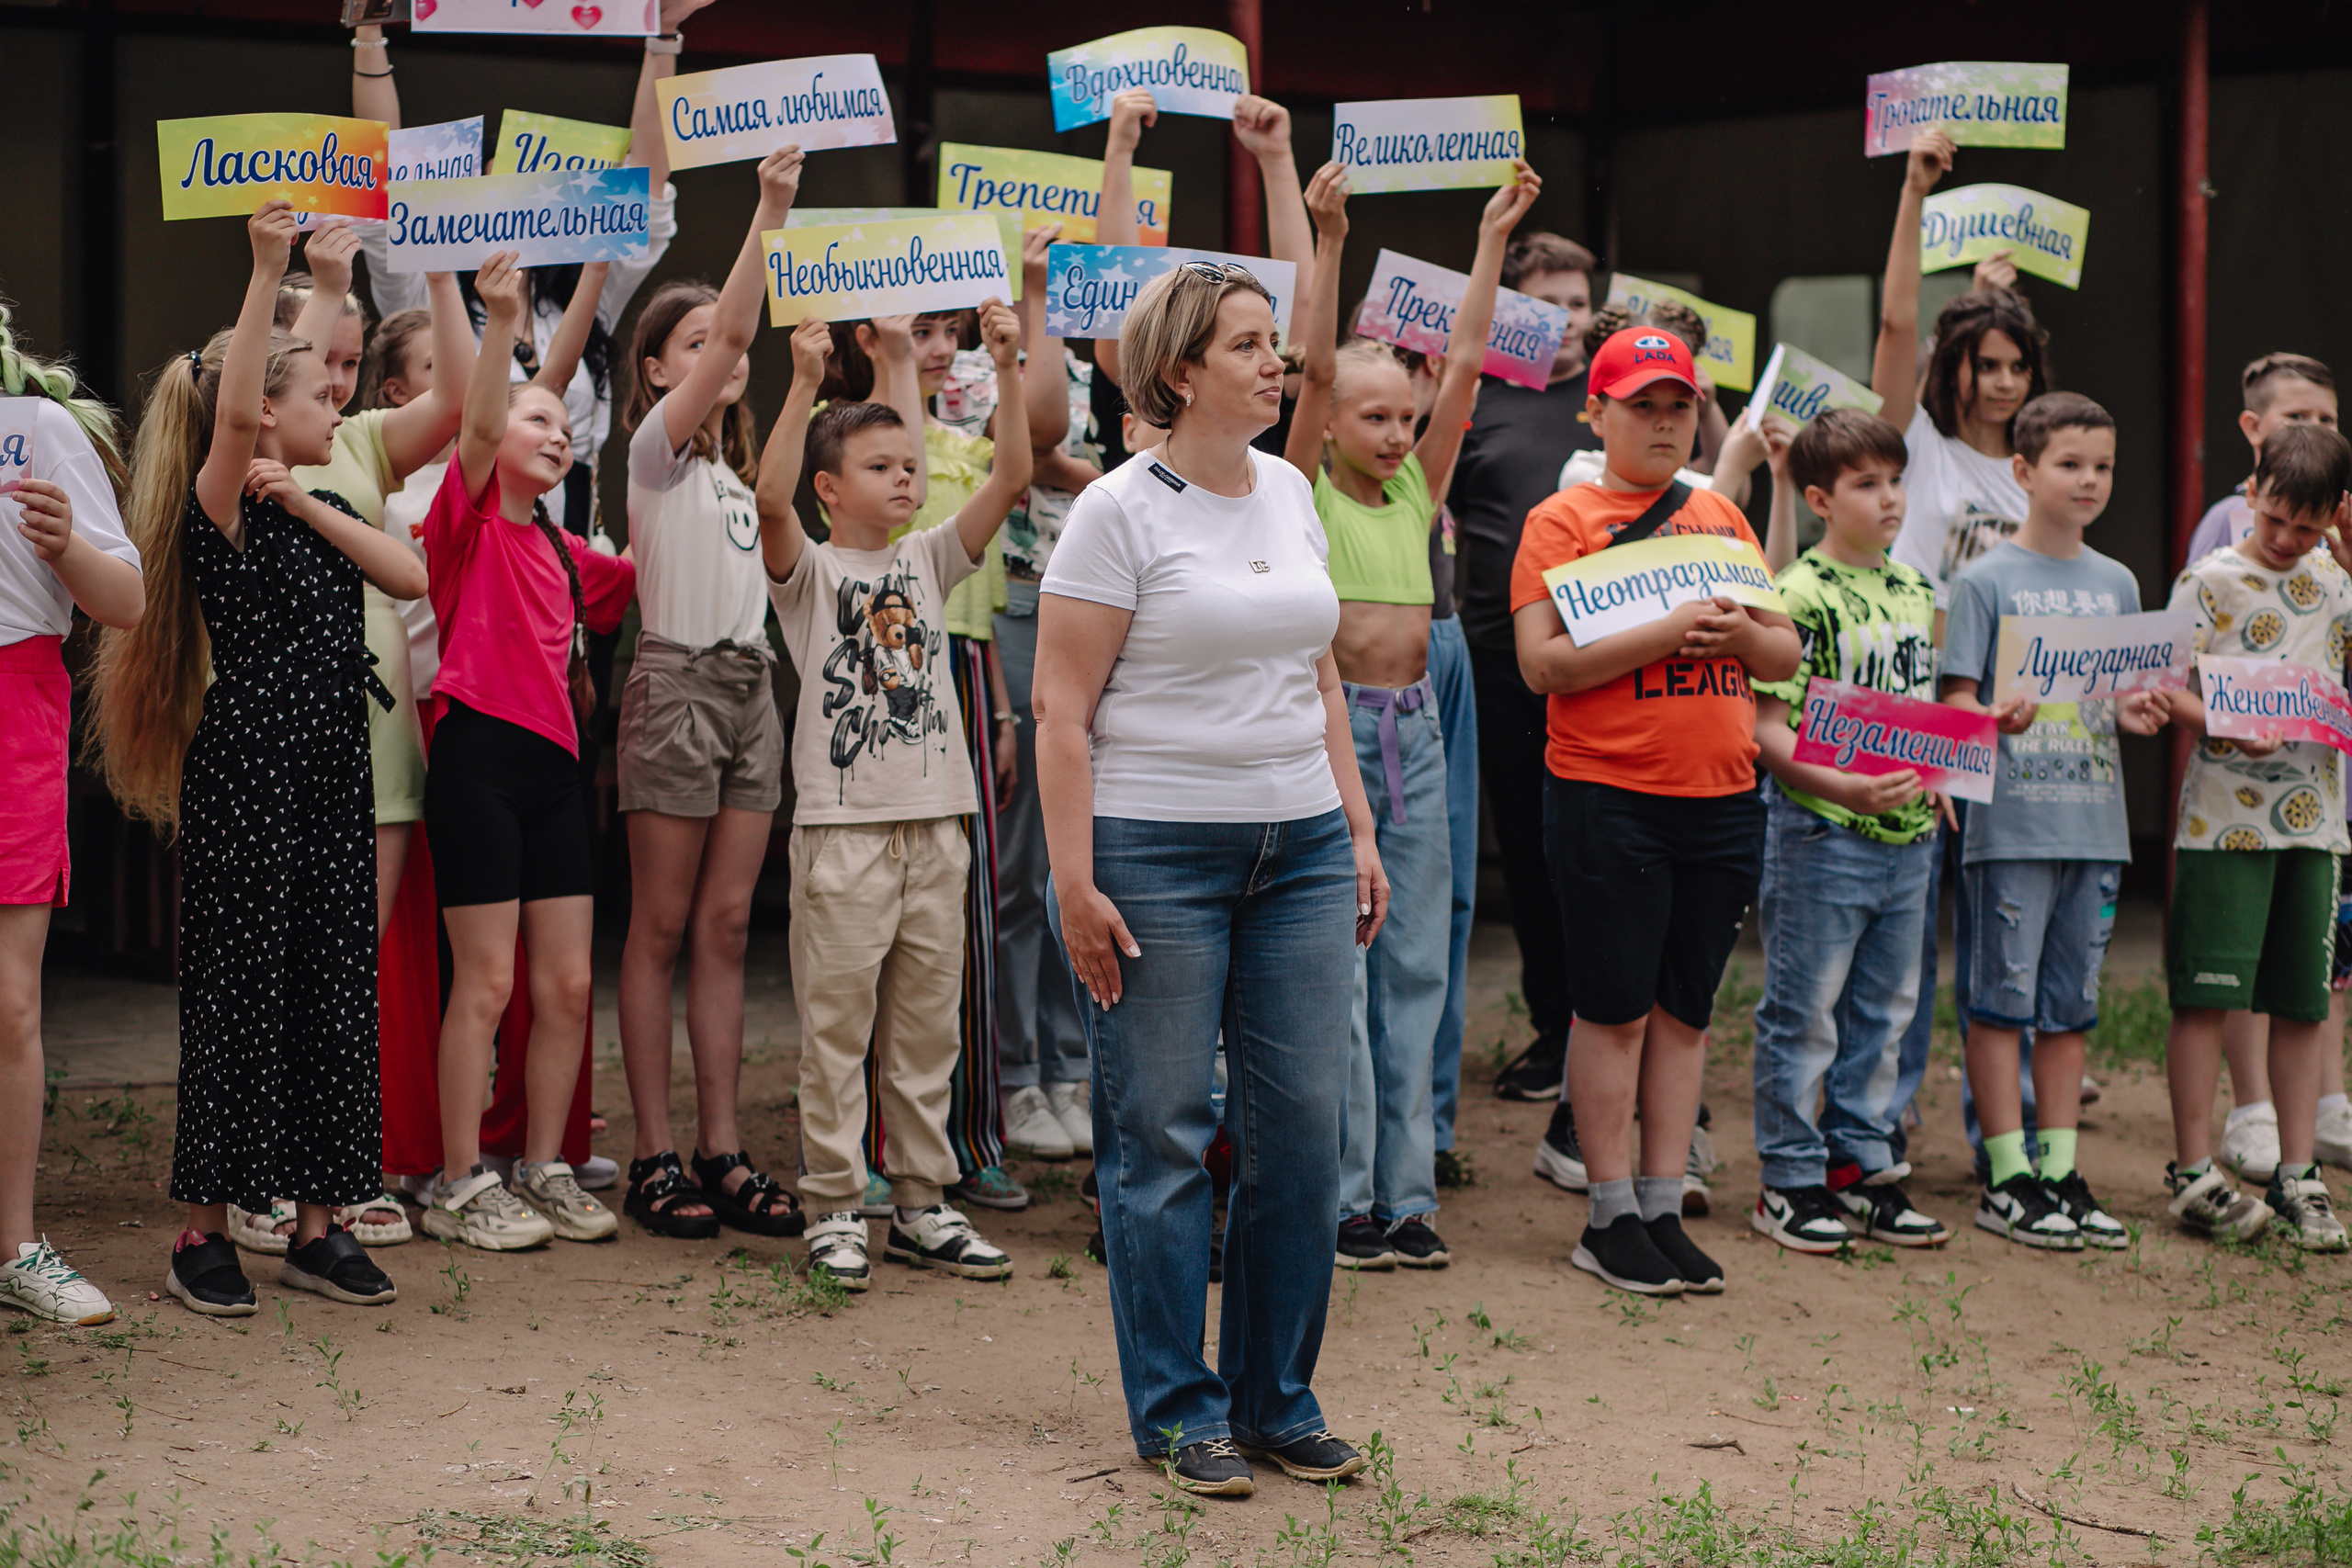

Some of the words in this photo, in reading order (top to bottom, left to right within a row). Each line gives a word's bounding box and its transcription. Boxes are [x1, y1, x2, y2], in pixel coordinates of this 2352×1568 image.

[673, 96, 772, 141] Самая
[776, 72, 884, 127] любимая
[1869, 93, 2061, 148] Трогательная
[181, 132, 377, 189] Ласковая
[1337, 123, 1522, 166] Великолепная
[390, 201, 649, 246] Замечательная
[1922, 203, 2074, 260] Душевная
[768, 235, 1005, 298] Необыкновенная
[1634, 351, 1676, 364] LADA
[1555, 560, 1775, 620] Неотразимая
[2018, 637, 2173, 696] Лучезарная
[1808, 698, 1992, 775] Незаменимая
[2012, 739, 2041, 753] THE
[2049, 739, 2094, 753] RULES
